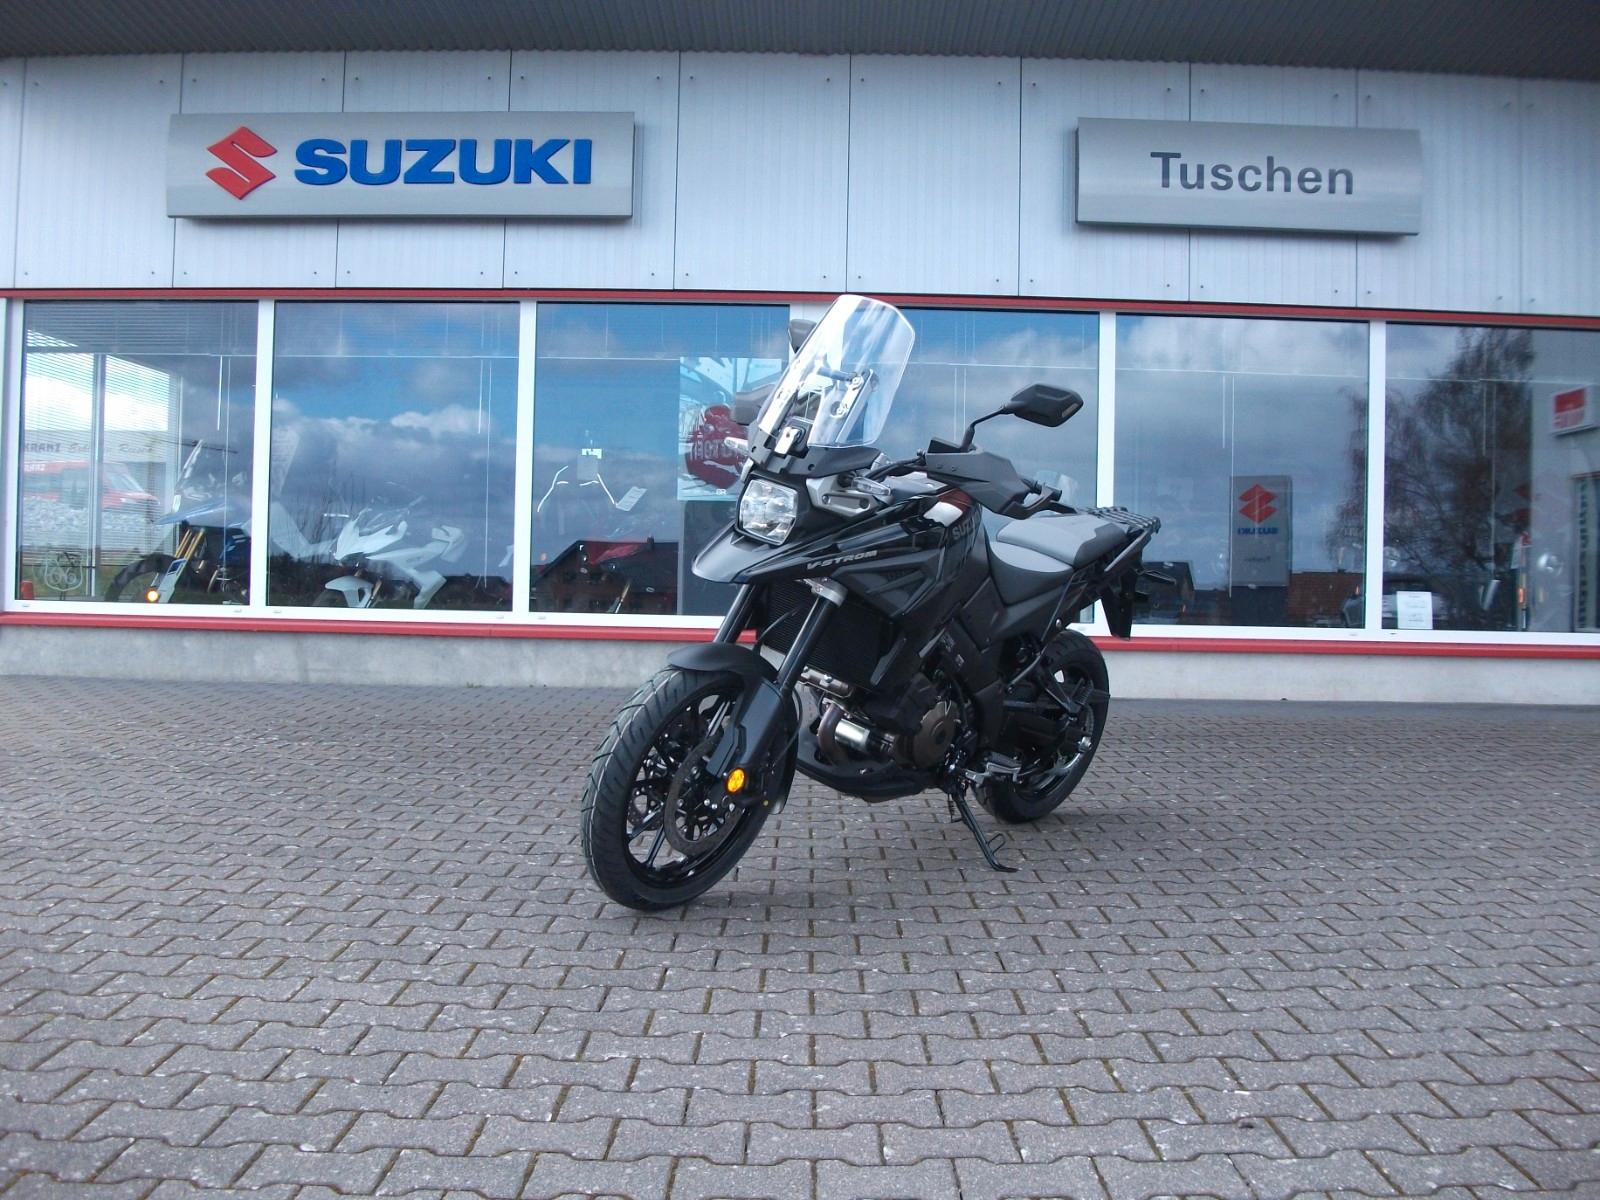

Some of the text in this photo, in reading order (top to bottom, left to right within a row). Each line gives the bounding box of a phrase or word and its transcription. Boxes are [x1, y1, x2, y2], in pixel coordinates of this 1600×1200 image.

[294, 138, 592, 185] SUZUKI
[1150, 151, 1353, 195] Tuschen
[807, 550, 878, 570] V-STROM
